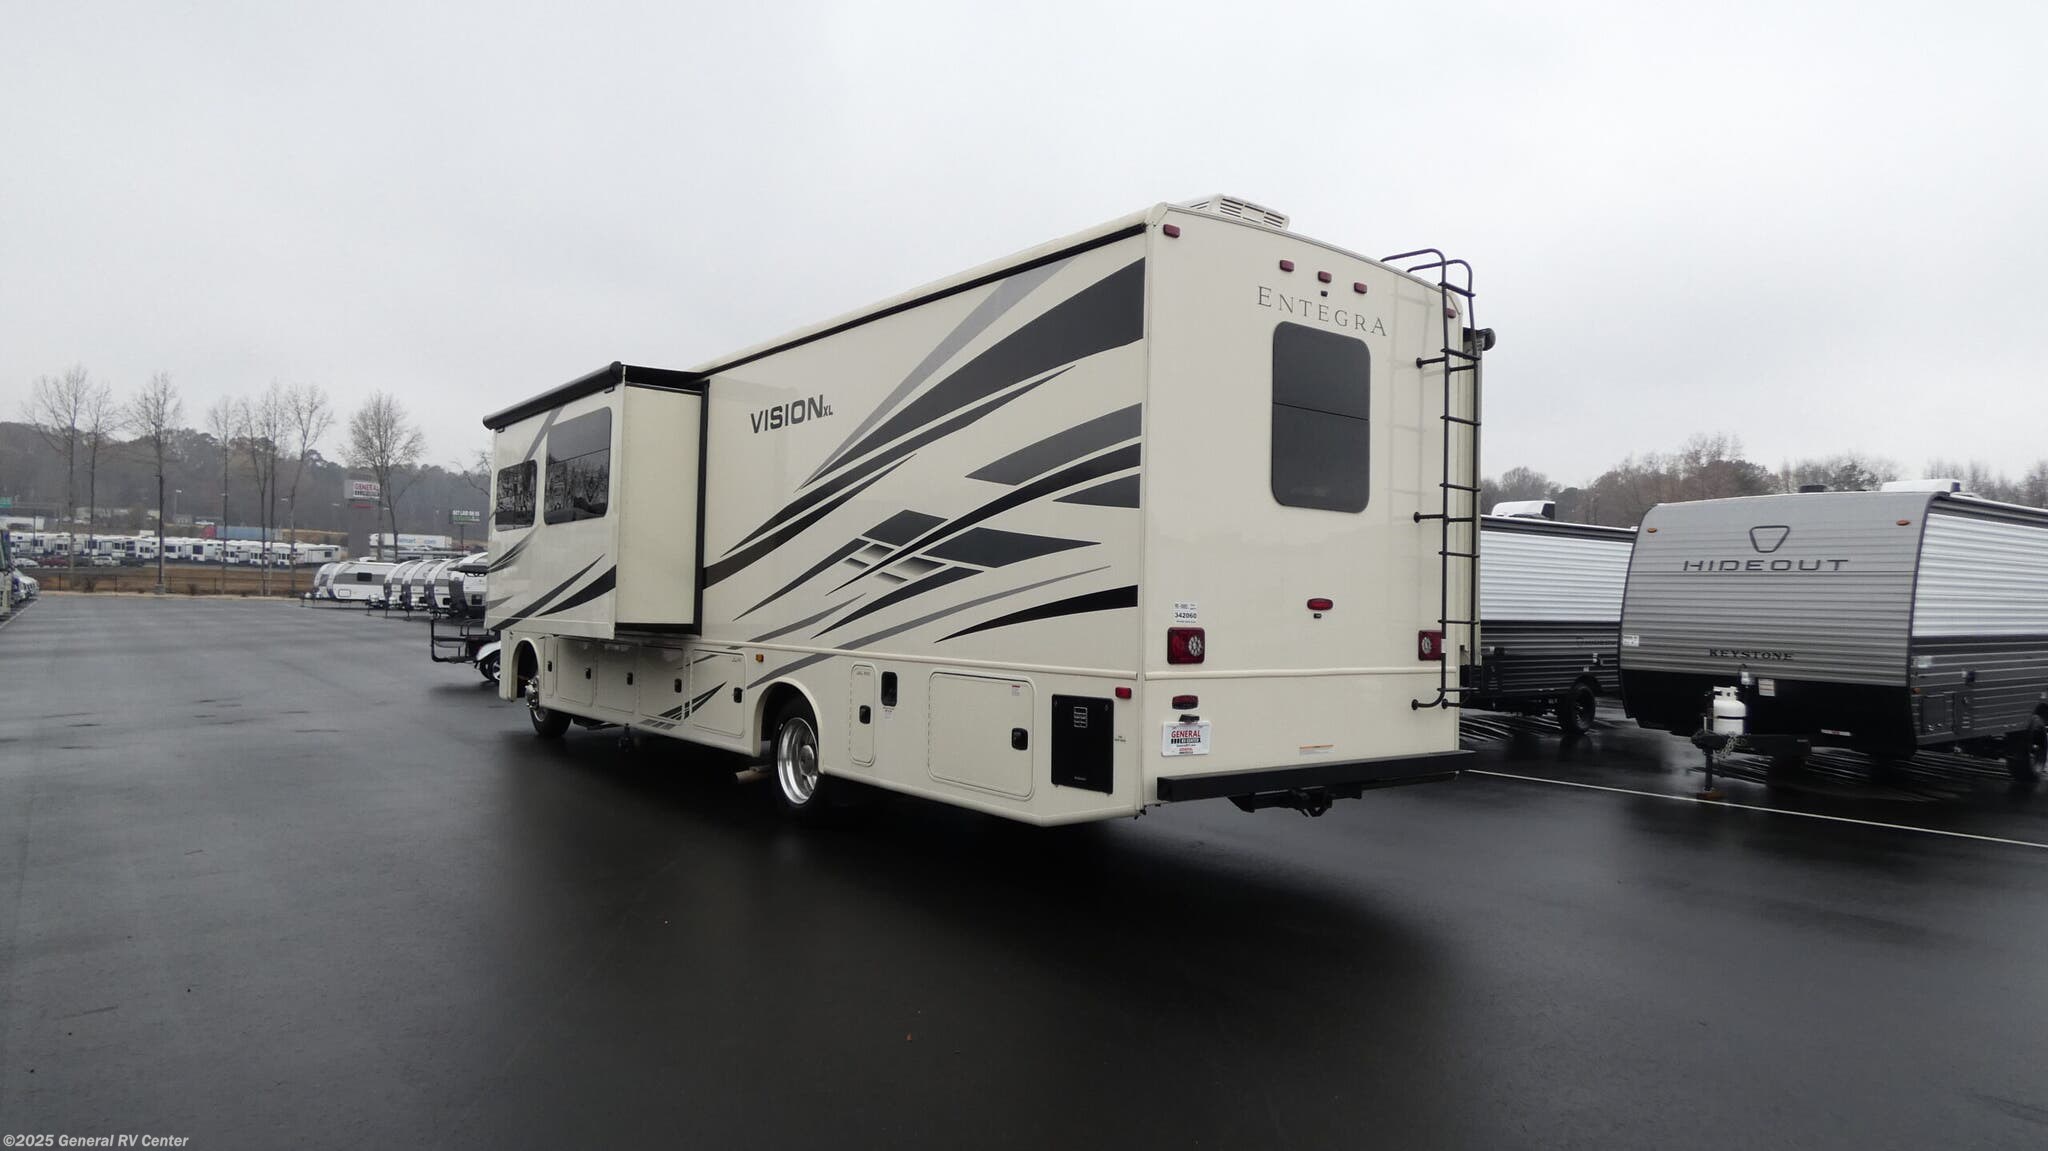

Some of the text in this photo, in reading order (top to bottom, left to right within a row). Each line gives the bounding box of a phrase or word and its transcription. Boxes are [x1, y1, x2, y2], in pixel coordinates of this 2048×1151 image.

[1258, 286, 1387, 336] ENTEGRA
[750, 394, 834, 434] VISION XL
[1683, 560, 1849, 571] HIDEOUT
[1709, 648, 1794, 661] KEYSTONE
[1171, 730, 1201, 738] GENERAL
